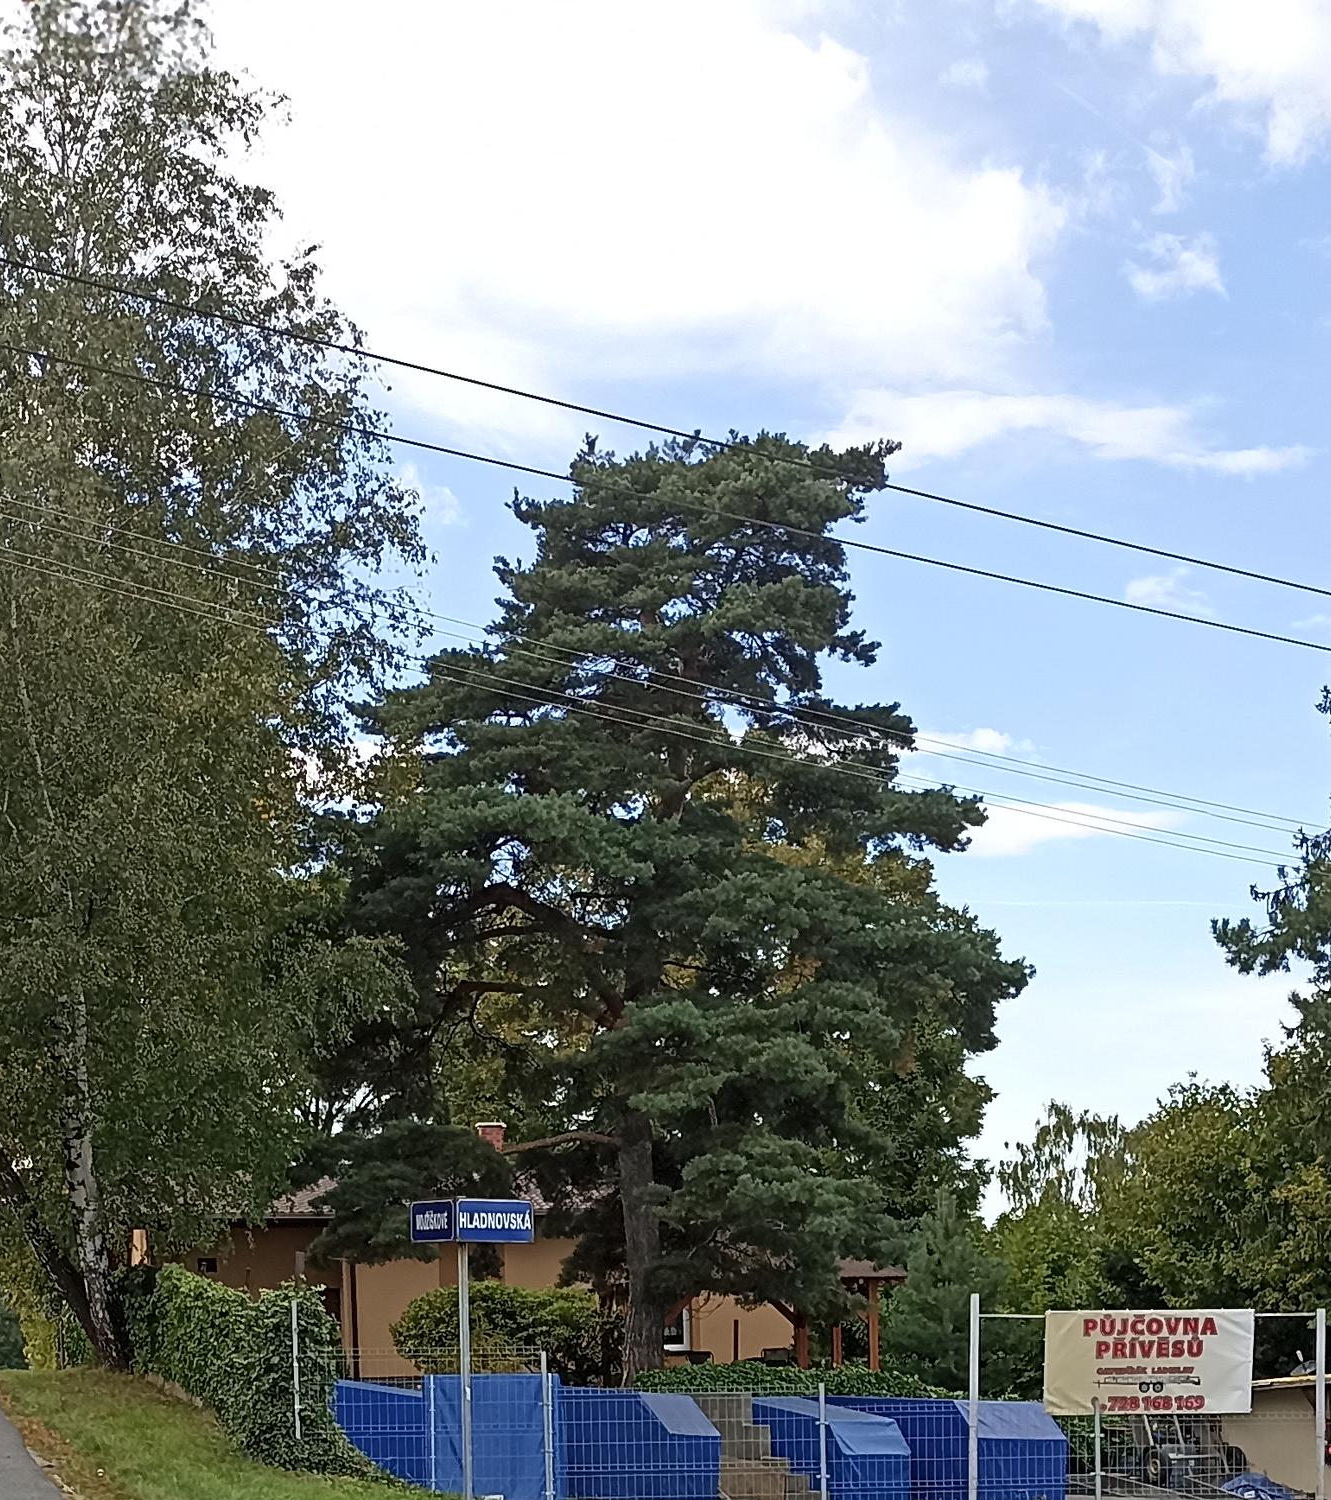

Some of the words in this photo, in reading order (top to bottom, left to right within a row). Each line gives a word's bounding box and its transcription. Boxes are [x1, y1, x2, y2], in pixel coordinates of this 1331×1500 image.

[459, 1210, 532, 1230] HLADNOVSKÁ
[1083, 1314, 1218, 1337] PŮJČOVNA
[1095, 1335, 1204, 1359] PŘÍVĚSŮ
[1108, 1396, 1140, 1411] 728
[1141, 1396, 1173, 1411] 168
[1174, 1395, 1206, 1410] 169
